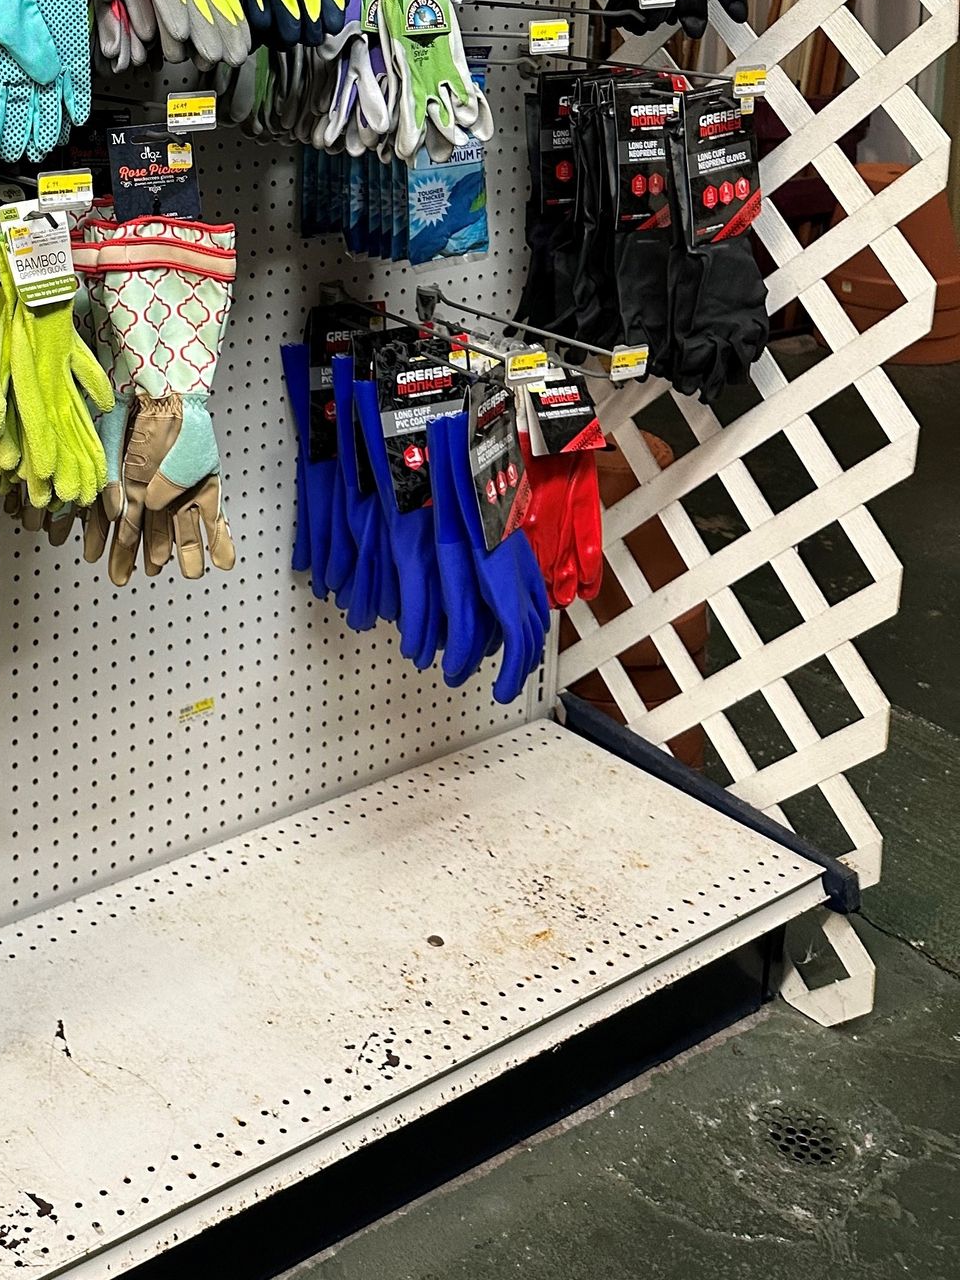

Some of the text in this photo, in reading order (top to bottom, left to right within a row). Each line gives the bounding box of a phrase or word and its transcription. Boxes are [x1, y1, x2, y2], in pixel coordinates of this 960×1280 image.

[426, 0, 443, 24] EARTH
[630, 103, 674, 116] GREASE
[699, 109, 742, 127] GREASE
[699, 118, 742, 138] MONKEY
[112, 132, 126, 145] M
[628, 140, 657, 150] LONG CUFF
[628, 148, 658, 158] NEOPRENE
[697, 149, 726, 162] LONG CUFF
[698, 151, 747, 171] NEOPRENE GLOVES
[119, 166, 148, 180] Rose
[418, 188, 444, 197] TOUGHER
[422, 193, 445, 202] THICKER
[16, 250, 67, 273] BAMBOO
[19, 264, 68, 280] GRIPPING GLOVE
[396, 365, 451, 384] GREASE
[397, 377, 453, 396] MONKEY
[538, 385, 579, 398] GREASE
[540, 392, 581, 405] MONKEY
[394, 406, 432, 420] LONG CUFF
[396, 418, 410, 429] PVC
